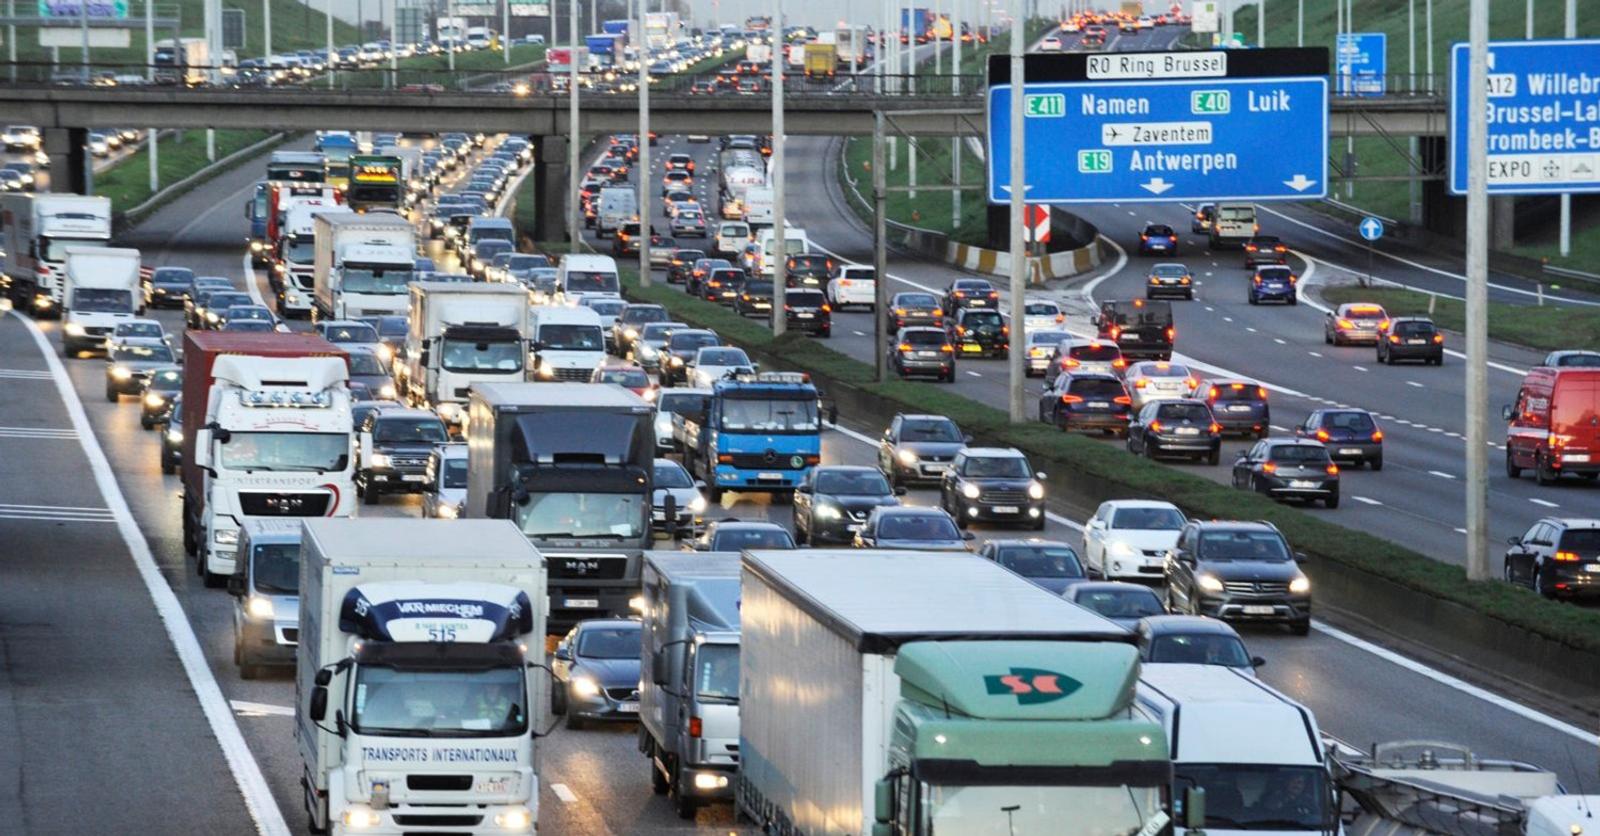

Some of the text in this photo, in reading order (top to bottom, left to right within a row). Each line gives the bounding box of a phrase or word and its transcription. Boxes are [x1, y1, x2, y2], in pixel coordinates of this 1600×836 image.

[1120, 57, 1155, 77] Ring
[1165, 54, 1224, 73] Brussel
[1081, 94, 1150, 115] Namen
[1194, 92, 1228, 112] E40
[1248, 90, 1291, 112] Luik
[1487, 101, 1600, 123] Brussel-La
[1132, 126, 1209, 143] Zaventem
[1485, 127, 1600, 151] rombeek-B
[1080, 150, 1238, 175] E19 Antwerpen
[1488, 160, 1531, 178] EXPO
[565, 561, 599, 570] MAN
[428, 628, 457, 642] 515
[362, 746, 519, 763] TRANSPORTS INTERNATIONAUX
